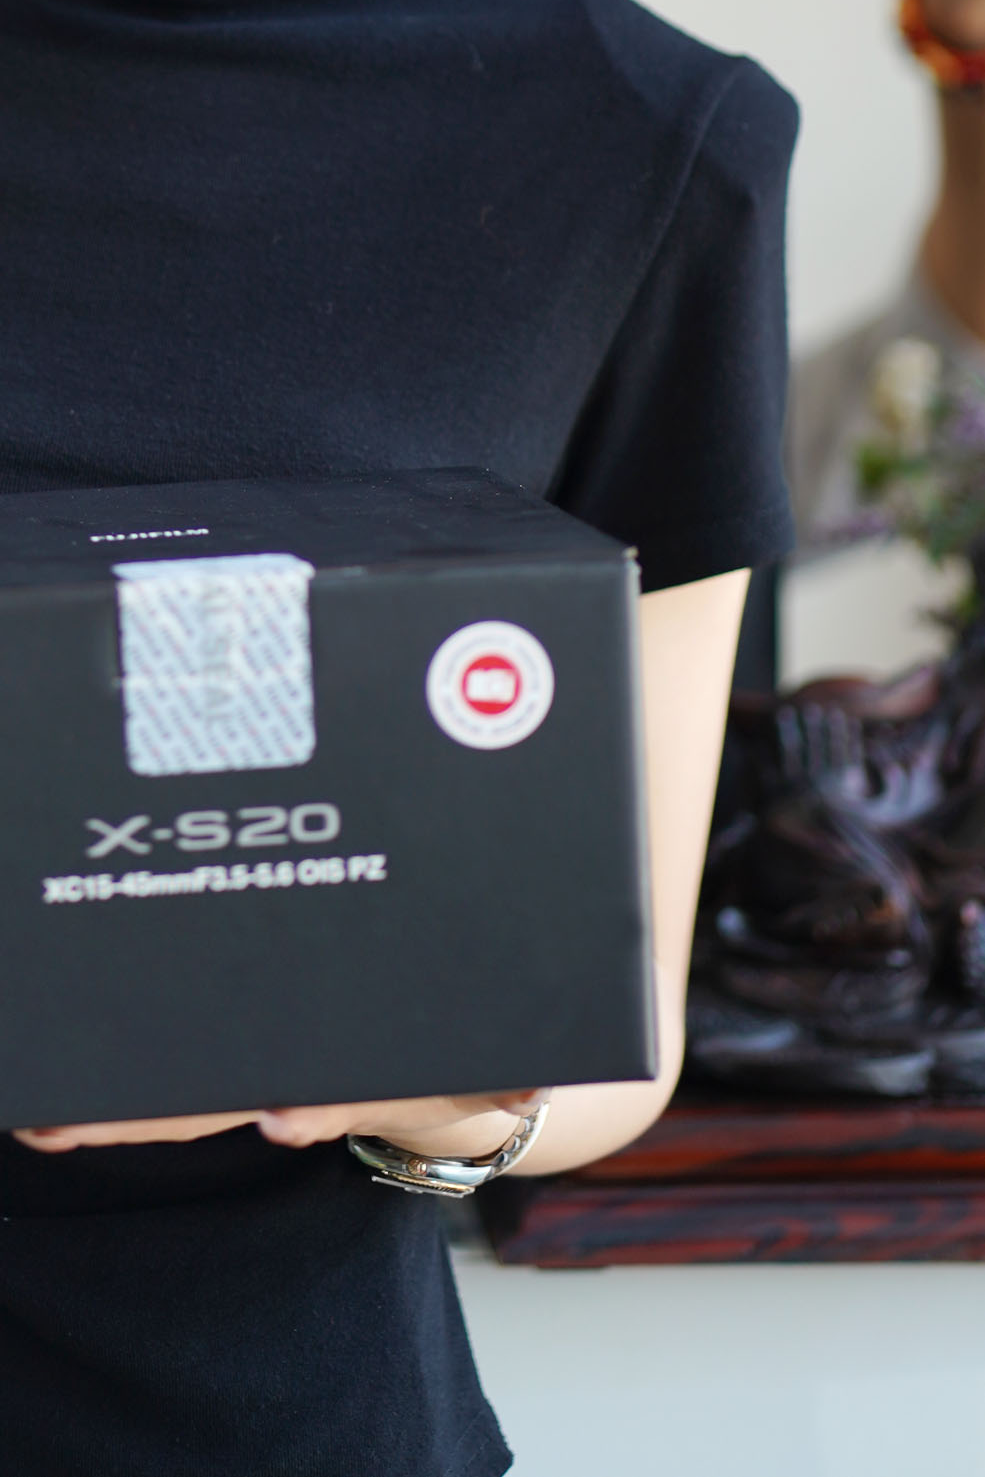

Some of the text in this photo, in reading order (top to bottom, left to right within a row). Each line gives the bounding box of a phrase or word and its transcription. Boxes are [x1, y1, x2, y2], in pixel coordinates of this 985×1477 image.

[85, 802, 341, 859] X-S20
[295, 857, 346, 886] OIS
[347, 854, 387, 882] PZ
